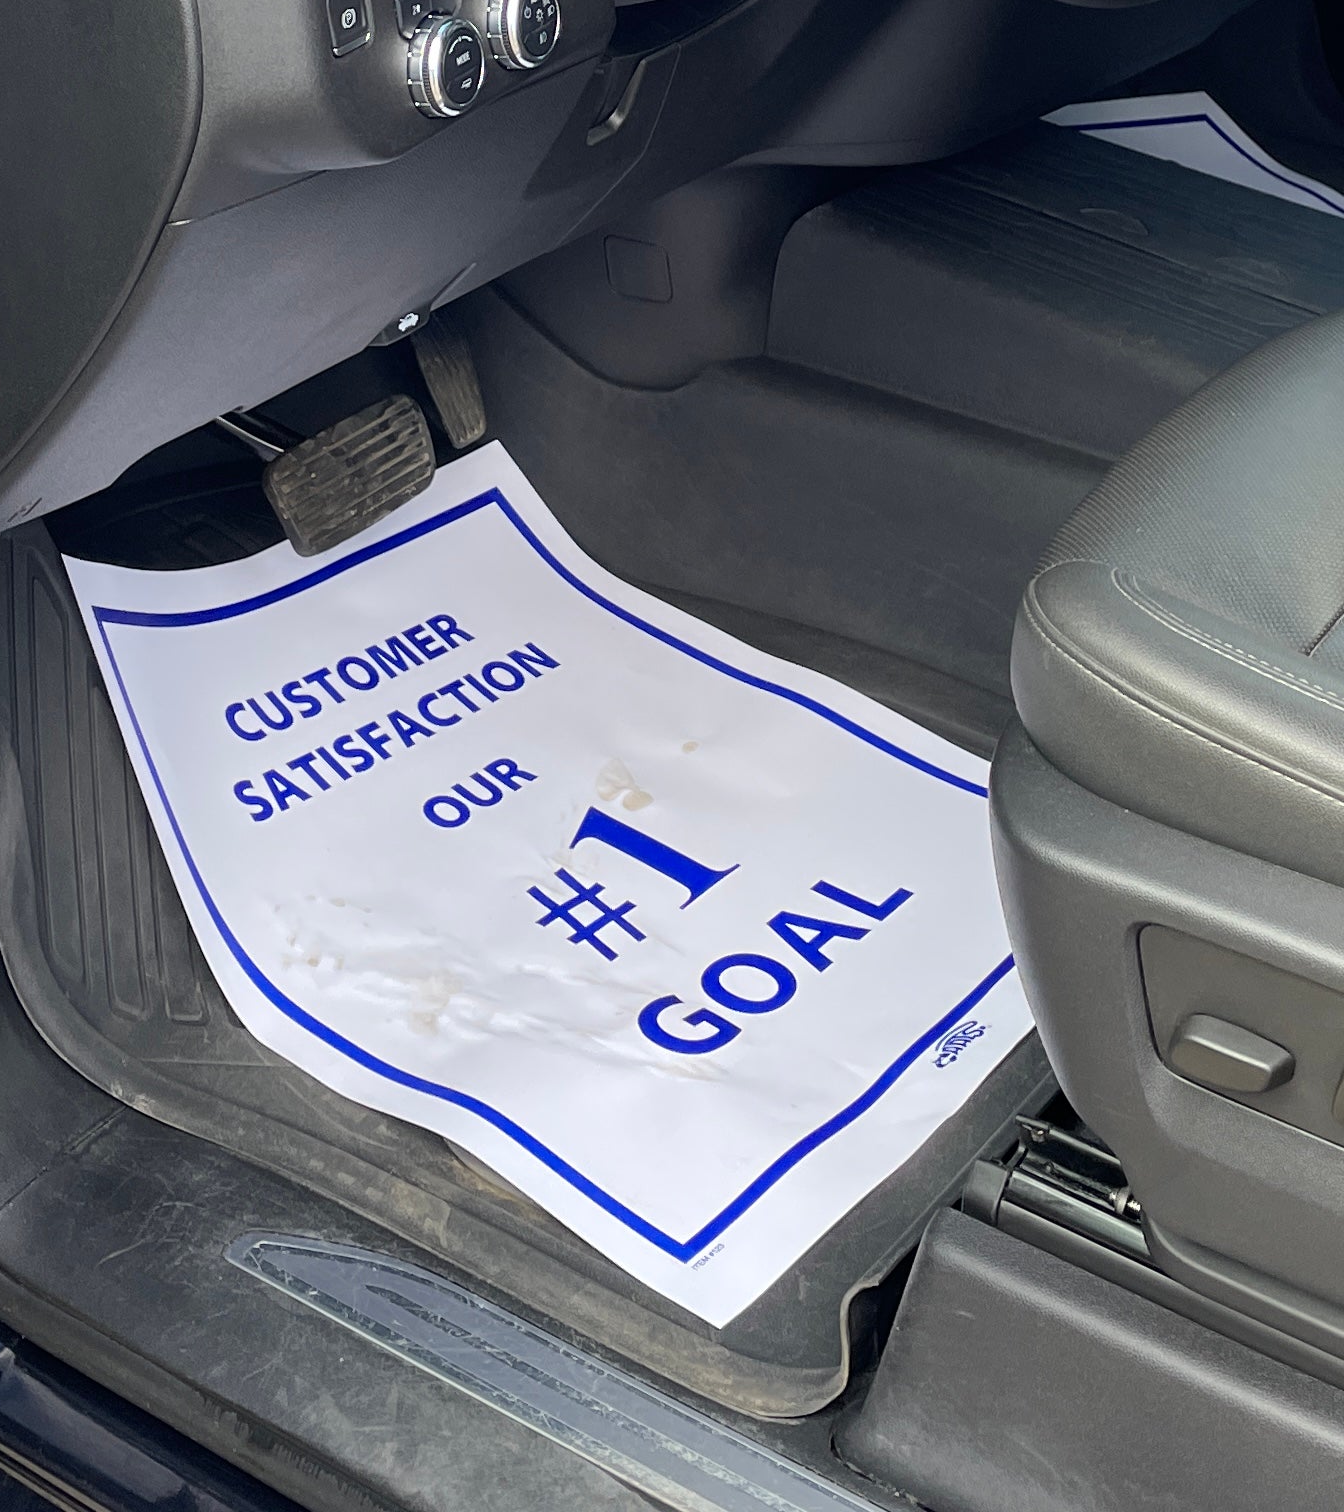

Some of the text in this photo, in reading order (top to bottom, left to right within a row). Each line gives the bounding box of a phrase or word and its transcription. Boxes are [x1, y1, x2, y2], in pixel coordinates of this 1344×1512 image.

[225, 614, 474, 743] CUSTOMER
[233, 642, 559, 823] SATISFACTION
[422, 758, 537, 829] OUR
[528, 807, 740, 962] #1
[637, 880, 913, 1056] GOAL
